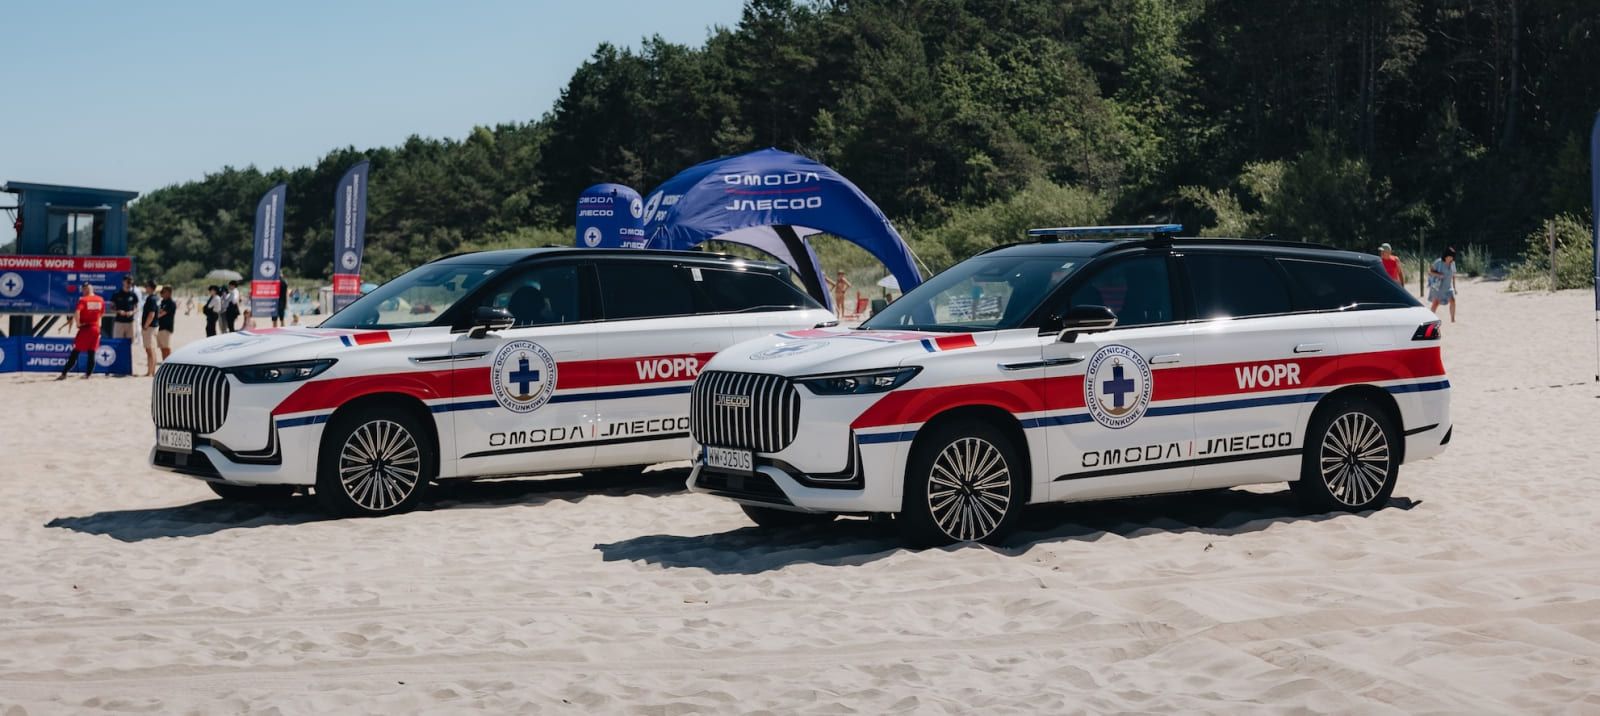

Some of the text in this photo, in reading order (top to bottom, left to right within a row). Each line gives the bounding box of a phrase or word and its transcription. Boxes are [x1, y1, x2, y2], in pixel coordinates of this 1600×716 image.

[724, 172, 820, 186] OMODA
[579, 209, 614, 217] JAECOO
[725, 196, 822, 211] JAECOO
[45, 259, 74, 268] WOPR
[497, 342, 537, 366] OCHOTNICZE
[538, 349, 554, 395] POGOTOWIE
[636, 357, 699, 380] WOPR
[1235, 362, 1301, 390] WOPR
[1087, 347, 1150, 413] WODNE OCHOTNICZE POGOTOWIE
[503, 396, 546, 411] RATUNKOWE
[1096, 409, 1141, 427] RATUNKOWE
[489, 417, 690, 447] OMODA JAECOO
[1081, 431, 1292, 468] OMODA JAECOO
[722, 450, 750, 469] 325US
